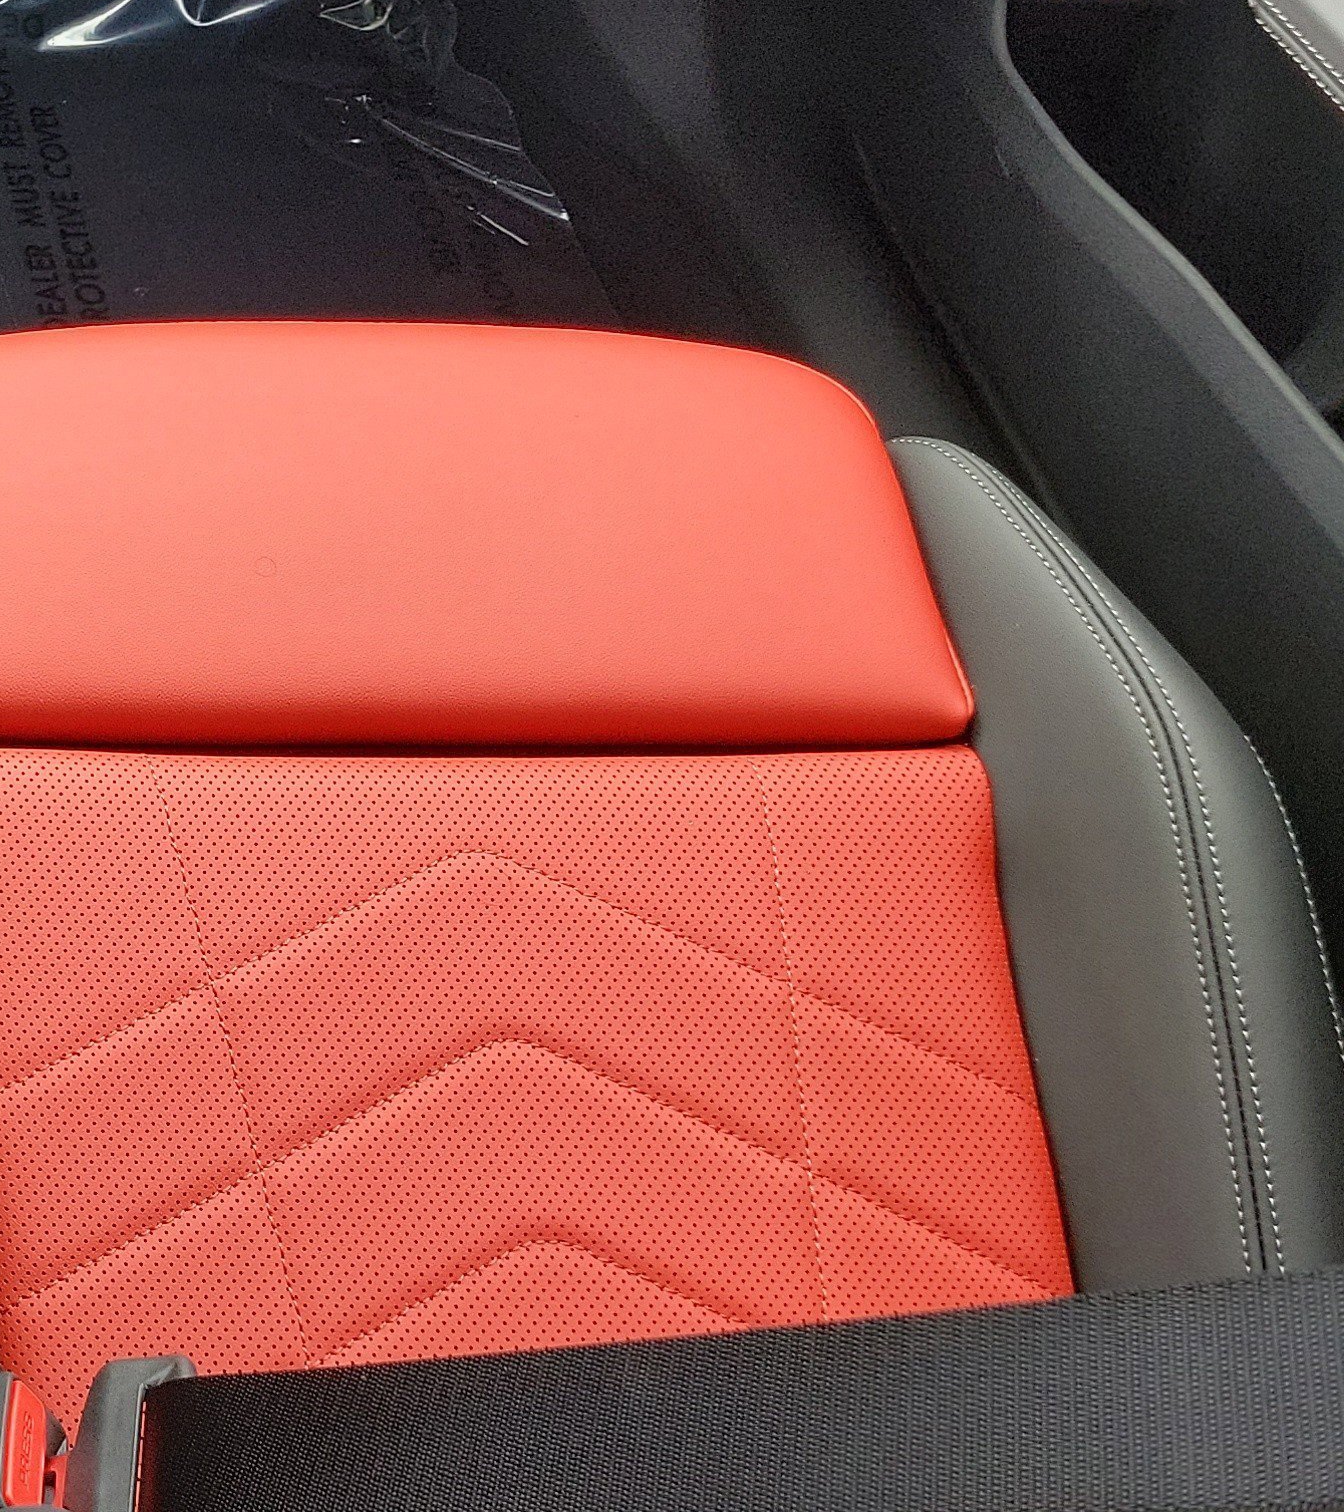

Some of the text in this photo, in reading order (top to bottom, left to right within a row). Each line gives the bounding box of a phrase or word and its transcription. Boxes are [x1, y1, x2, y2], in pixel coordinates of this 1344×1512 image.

[2, 160, 48, 229] MUST
[29, 104, 110, 320] ROTECTIVE COVER
[18, 1410, 35, 1488] PRESS
